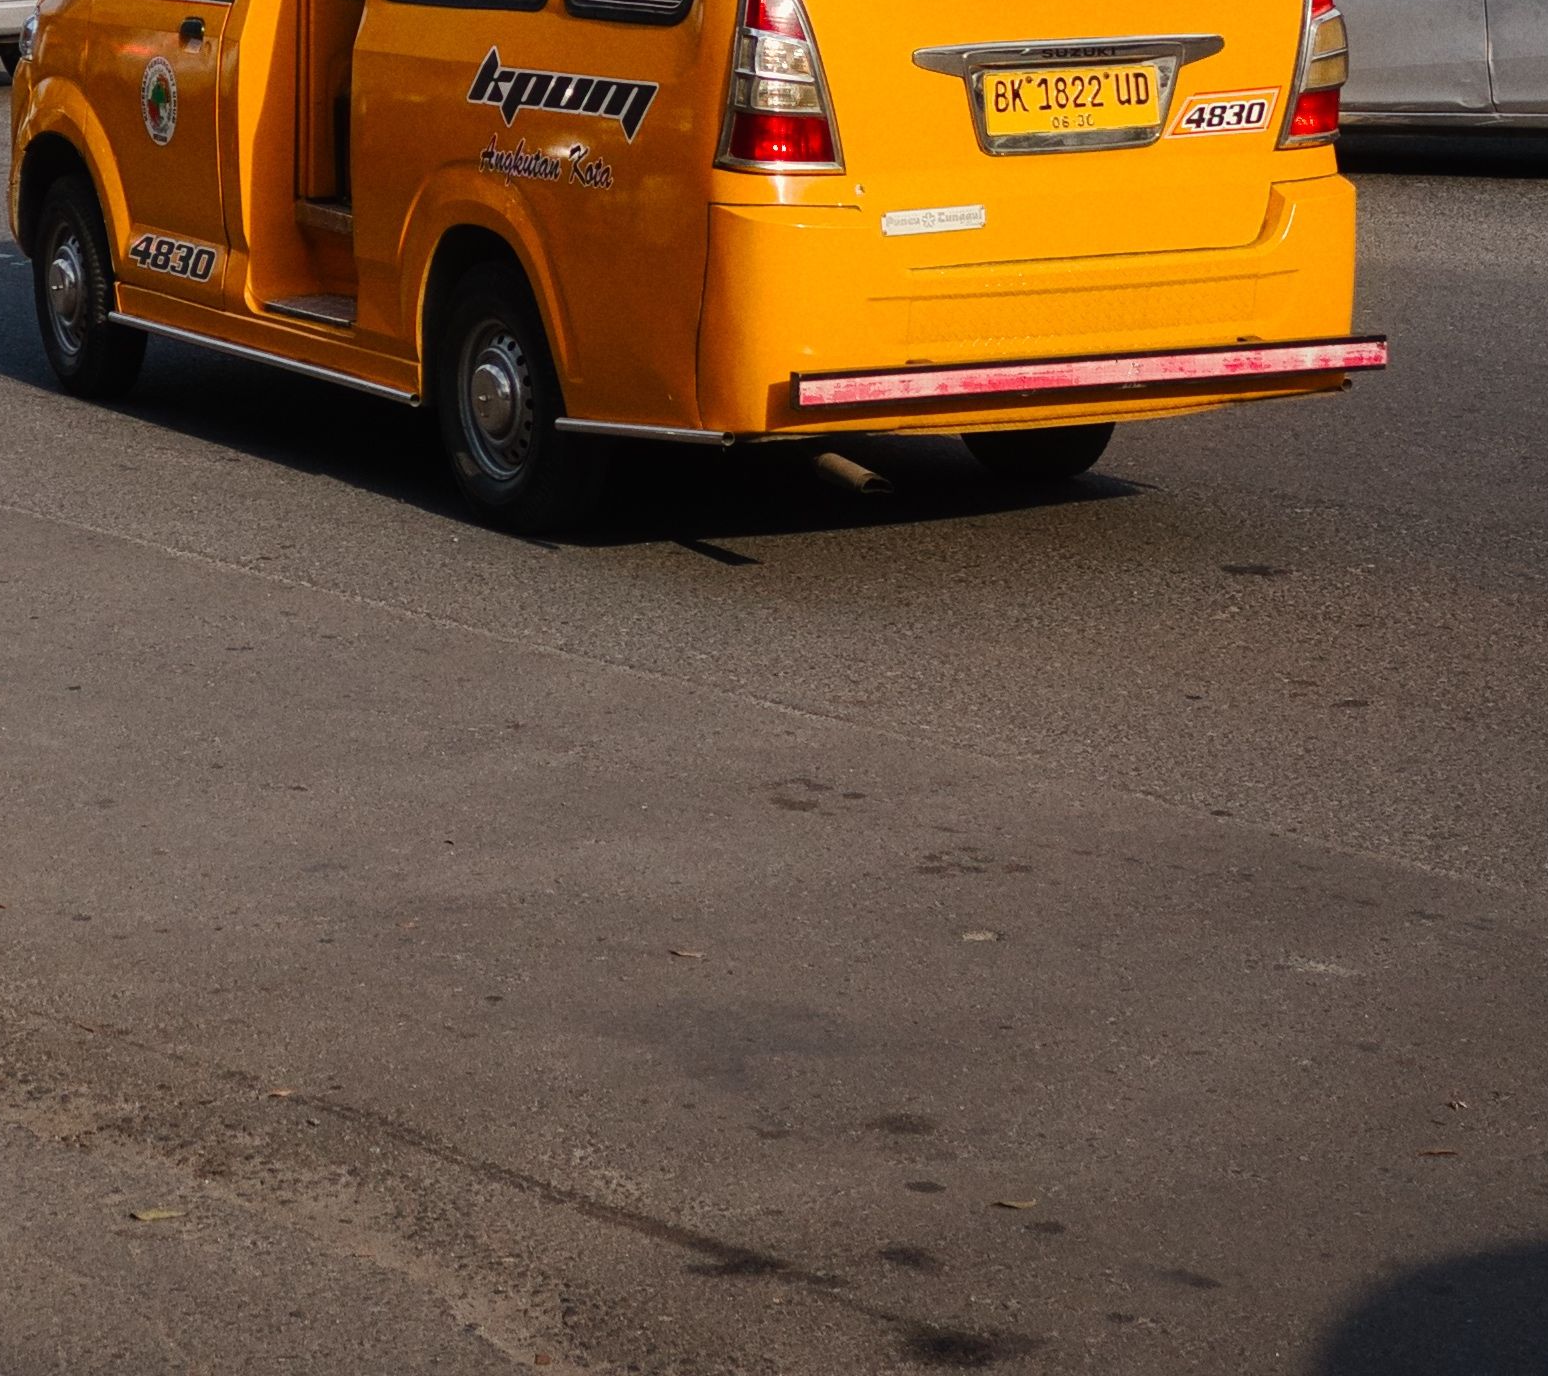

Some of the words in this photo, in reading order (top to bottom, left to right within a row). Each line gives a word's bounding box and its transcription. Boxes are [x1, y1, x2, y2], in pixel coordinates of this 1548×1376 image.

[1041, 47, 1118, 59] SUZUKI
[993, 79, 1030, 113] BK
[1037, 73, 1105, 111] 1822
[1115, 71, 1150, 106] UD
[1183, 100, 1268, 133] 4830
[479, 132, 562, 187] Angkutan
[568, 142, 615, 191] Kota
[129, 233, 217, 283] 4830
